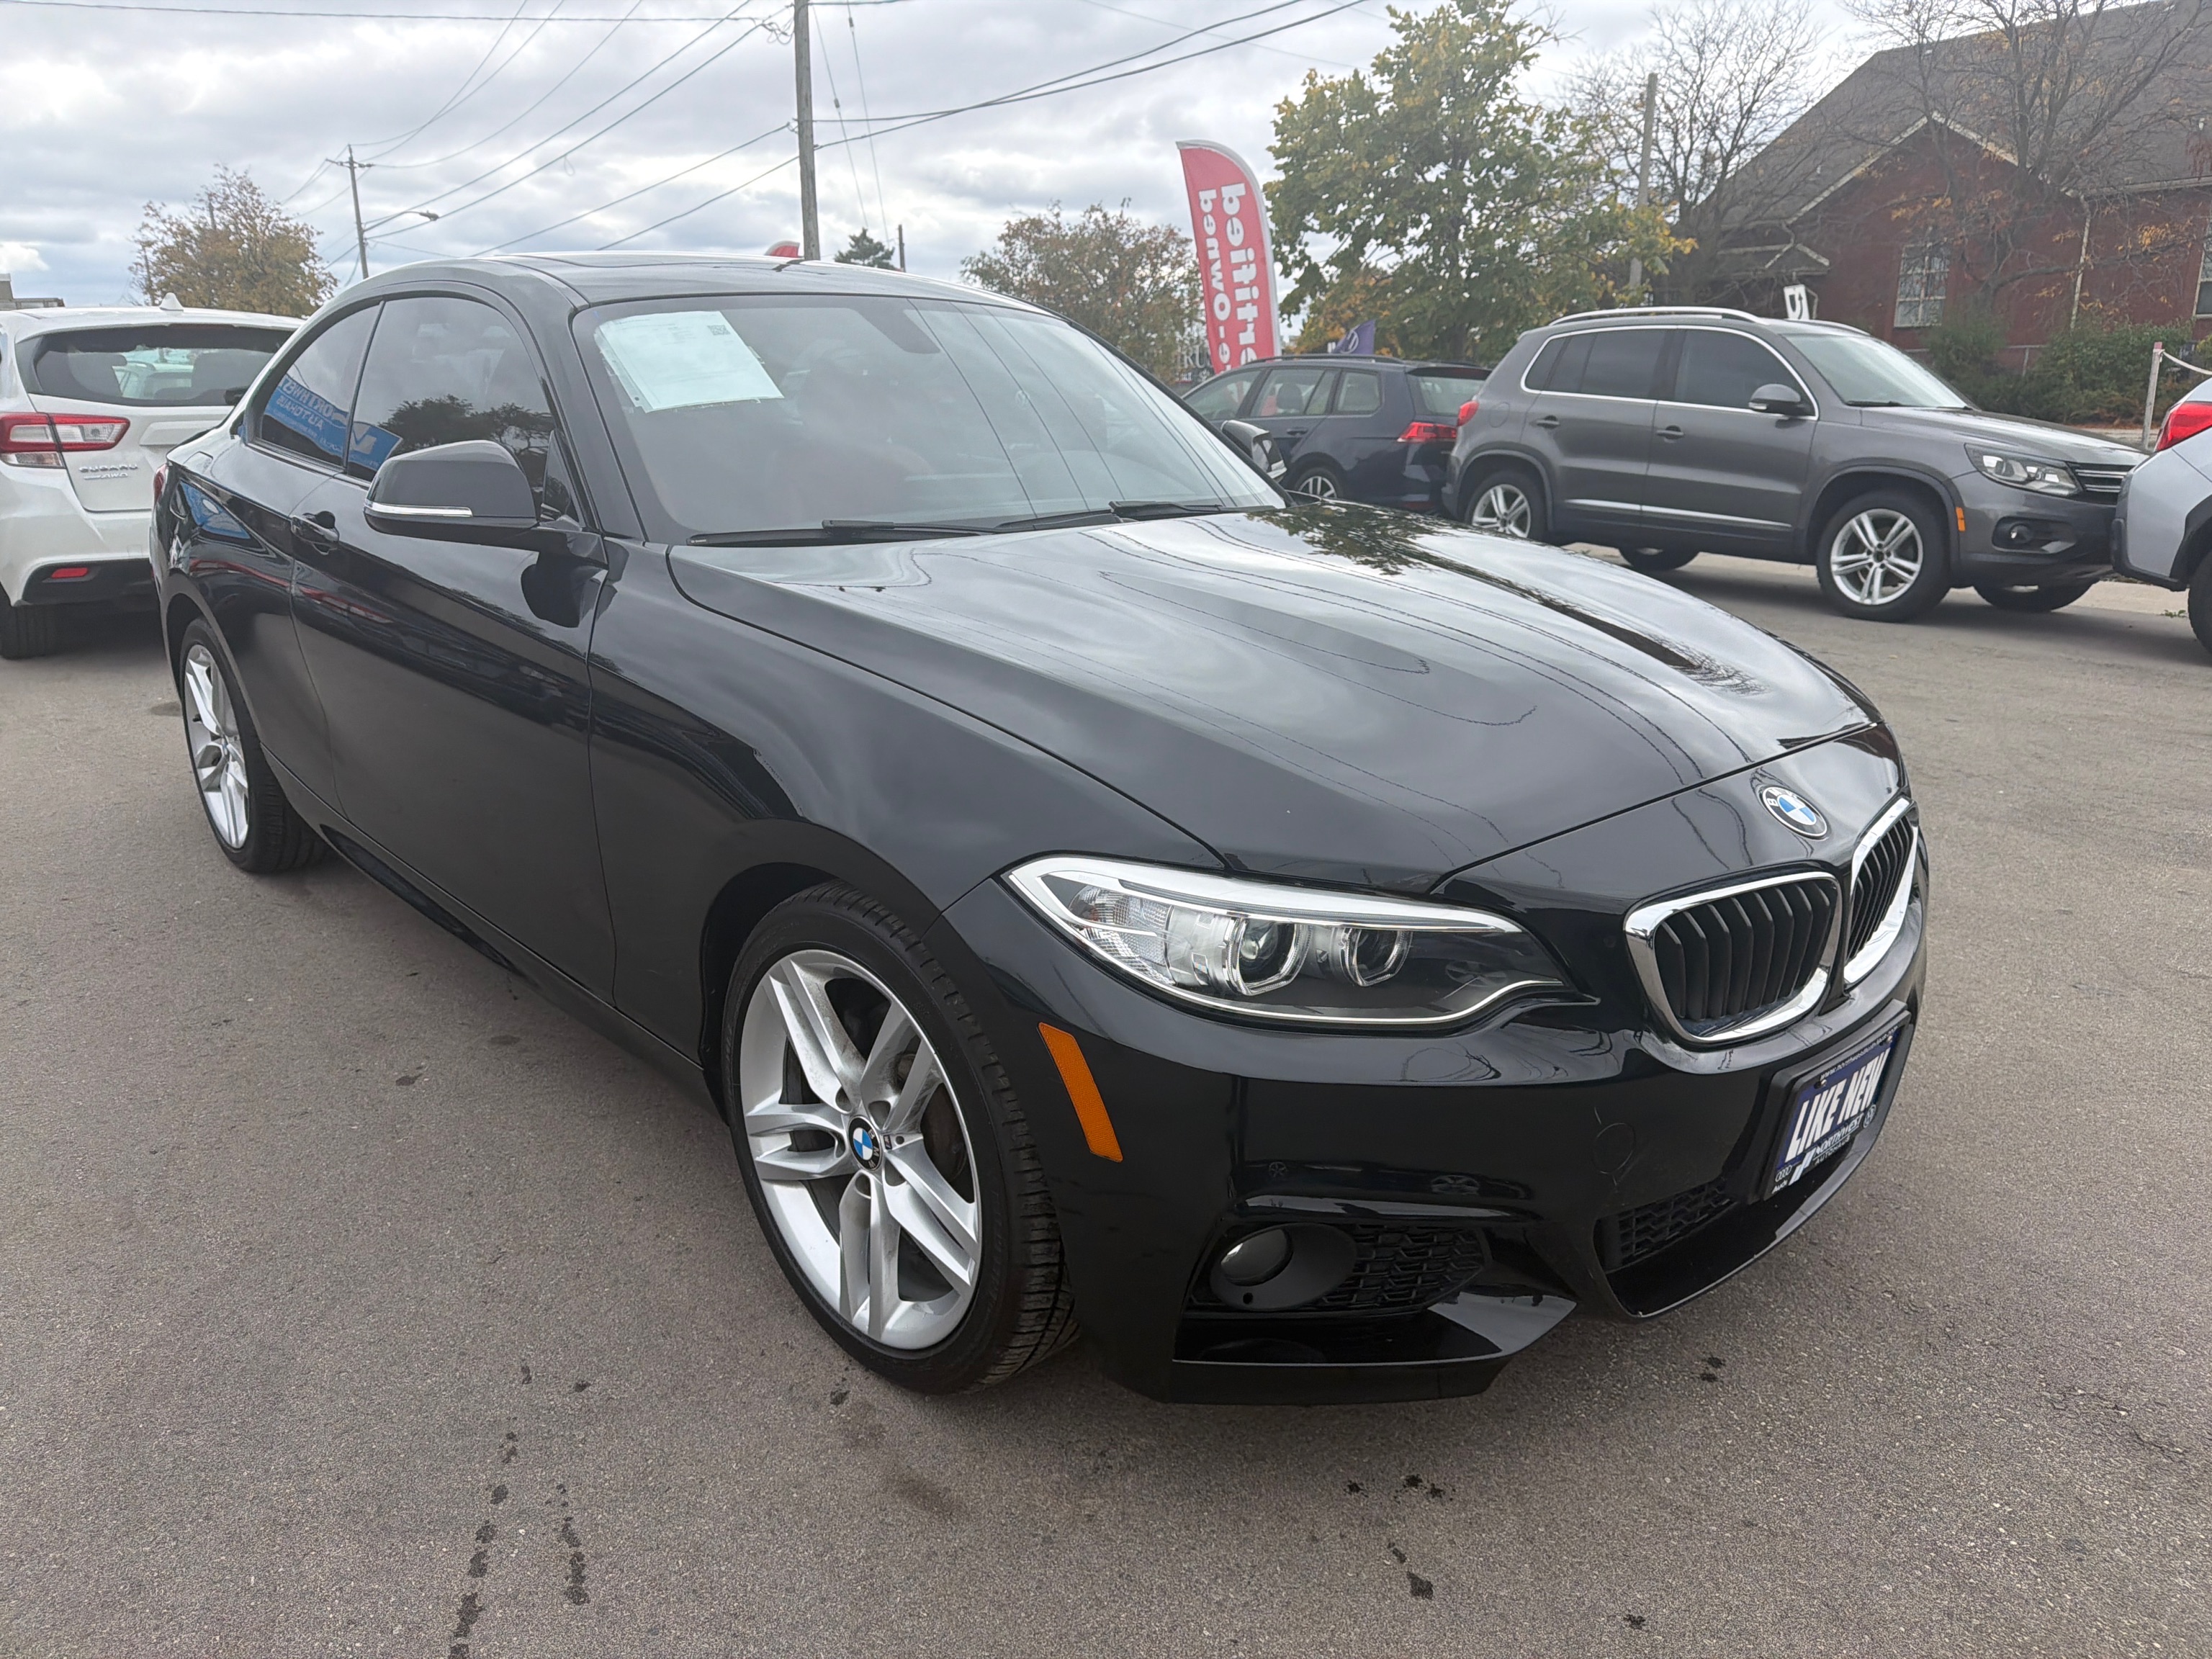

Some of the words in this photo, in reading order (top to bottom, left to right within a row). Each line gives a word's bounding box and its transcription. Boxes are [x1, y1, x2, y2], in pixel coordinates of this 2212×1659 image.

[78, 464, 138, 473] SUBARU
[1784, 1078, 1848, 1164] LIKE
[1838, 1046, 1892, 1125] NEW
[1812, 1135, 1851, 1166] AUTOHAUS
[1771, 1179, 1788, 1195] Audi
